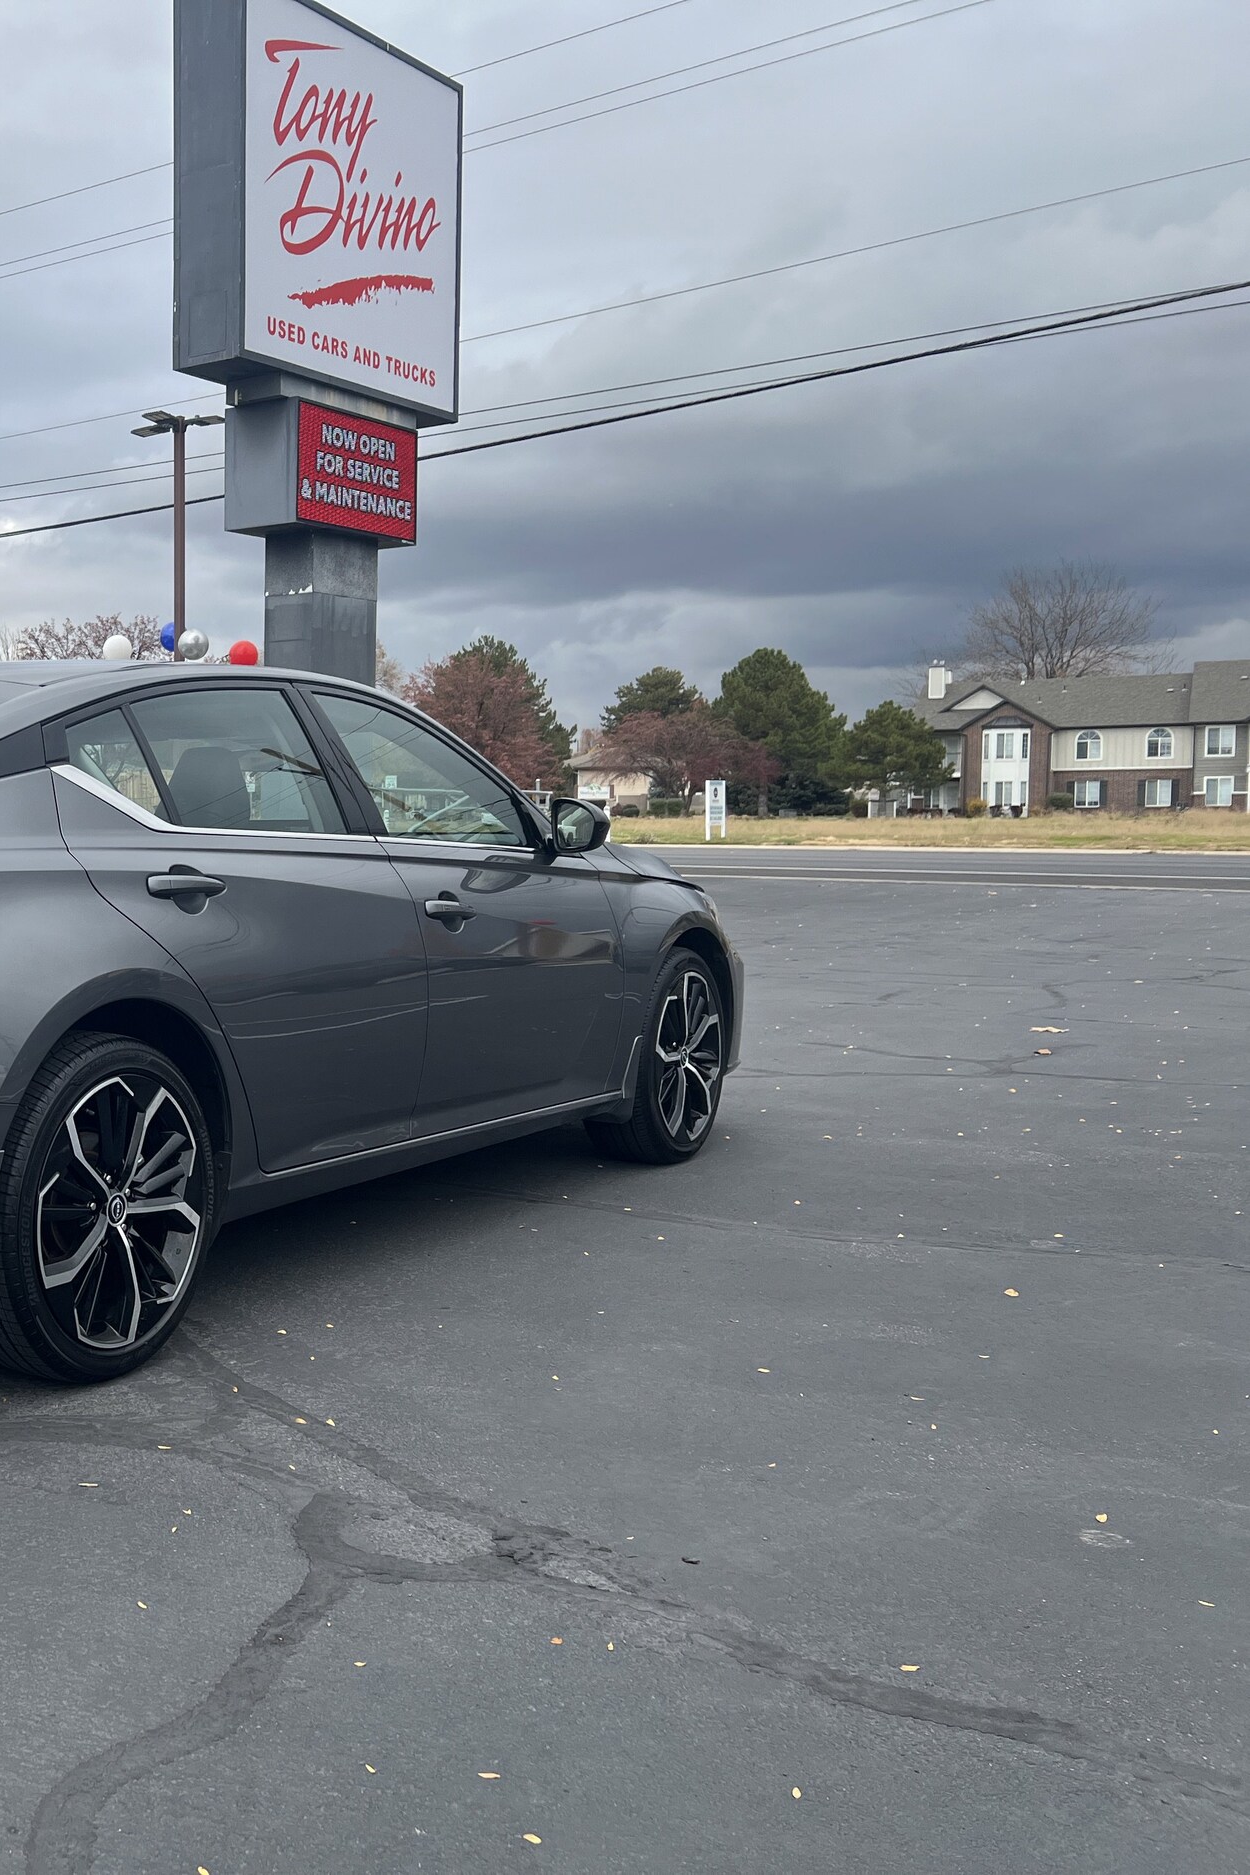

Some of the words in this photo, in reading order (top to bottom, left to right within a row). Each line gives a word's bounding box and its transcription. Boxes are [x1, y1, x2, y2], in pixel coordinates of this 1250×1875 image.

[265, 39, 377, 183] Tony
[264, 149, 441, 255] Divino
[267, 315, 306, 345] USED
[311, 331, 348, 359] CARS
[353, 345, 380, 369] AND
[385, 355, 436, 387] TRUCKS
[315, 450, 344, 477] FOR
[347, 458, 400, 490] SERVICE
[321, 423, 358, 451] NOW
[359, 434, 396, 462] OPEN
[301, 478, 312, 499] &
[315, 480, 412, 521] MAINTENANCE
